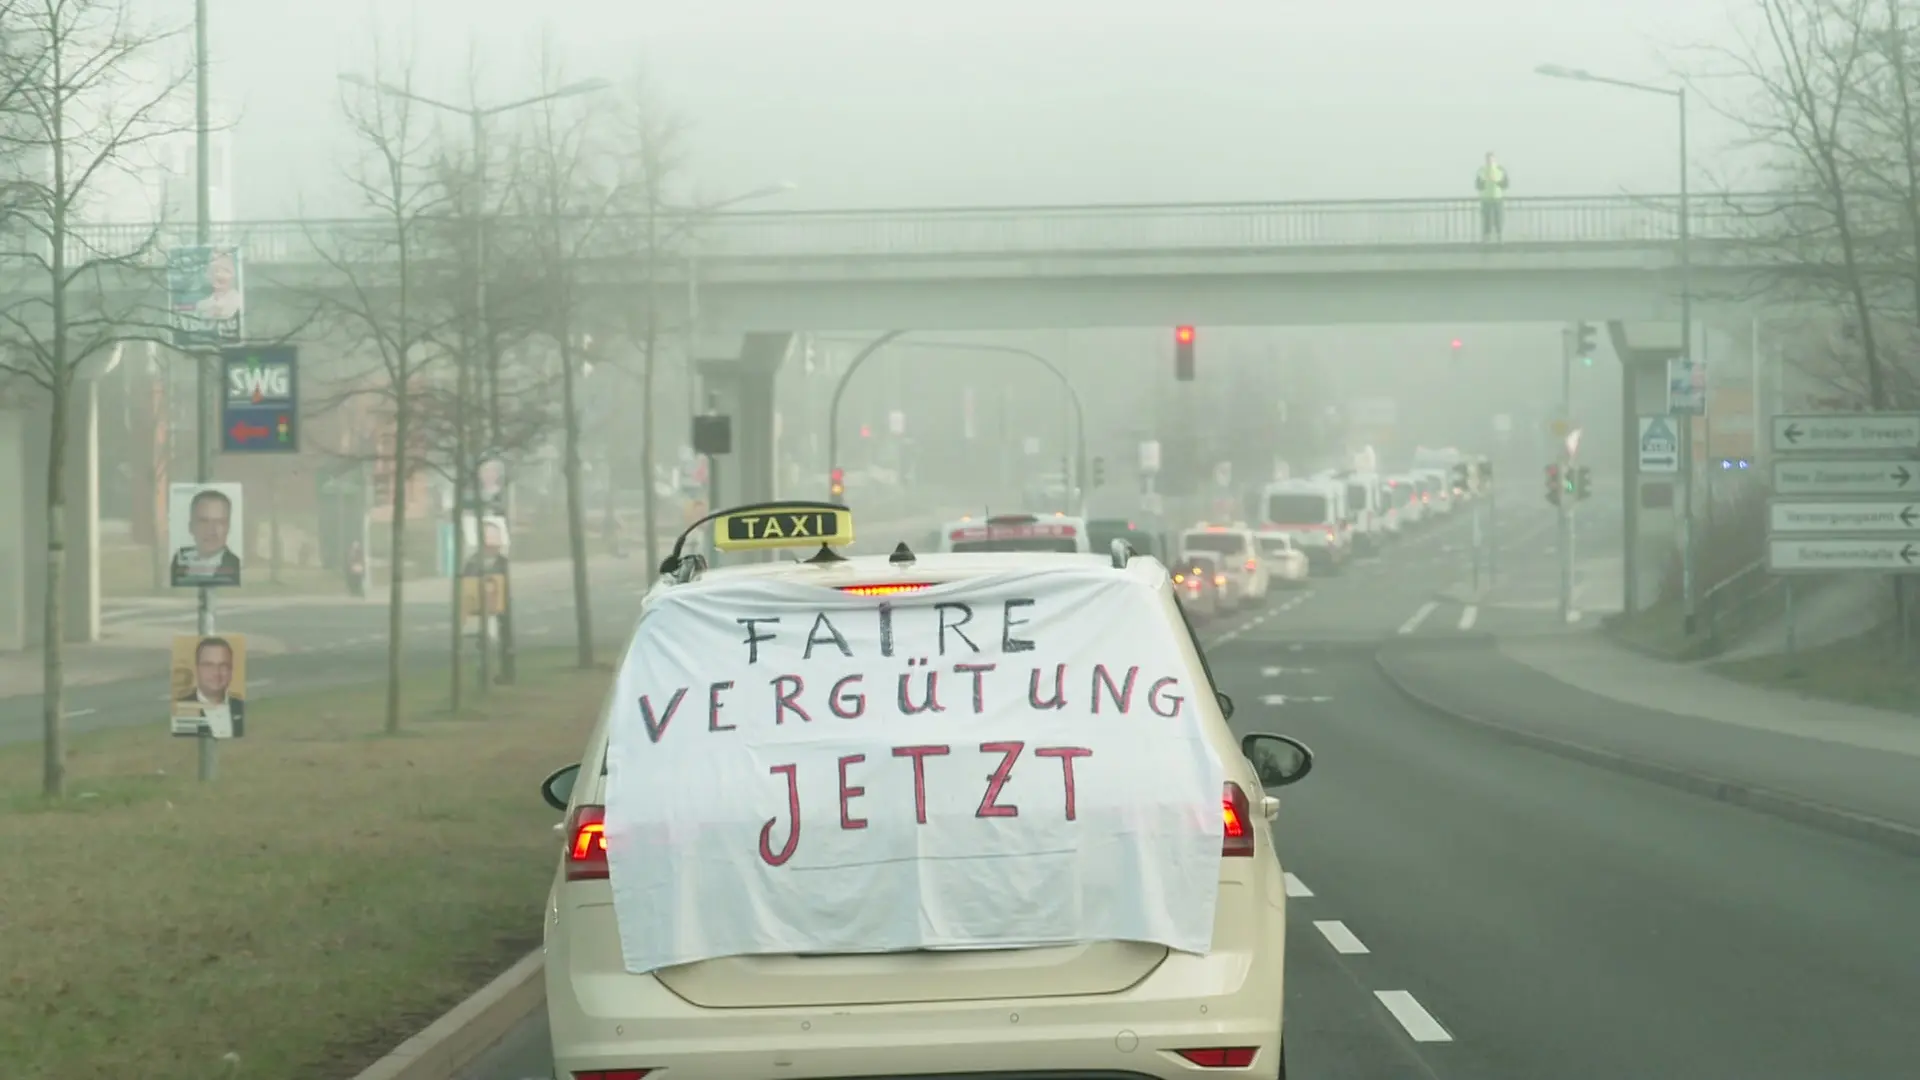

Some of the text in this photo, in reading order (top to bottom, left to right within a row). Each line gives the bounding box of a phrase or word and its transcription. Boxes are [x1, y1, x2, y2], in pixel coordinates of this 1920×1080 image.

[230, 367, 288, 396] SWG
[741, 514, 823, 538] TAXI
[737, 599, 1036, 664] FAIRE
[638, 658, 1185, 743] VERGÜTUNG
[759, 741, 1093, 867] JETZT
